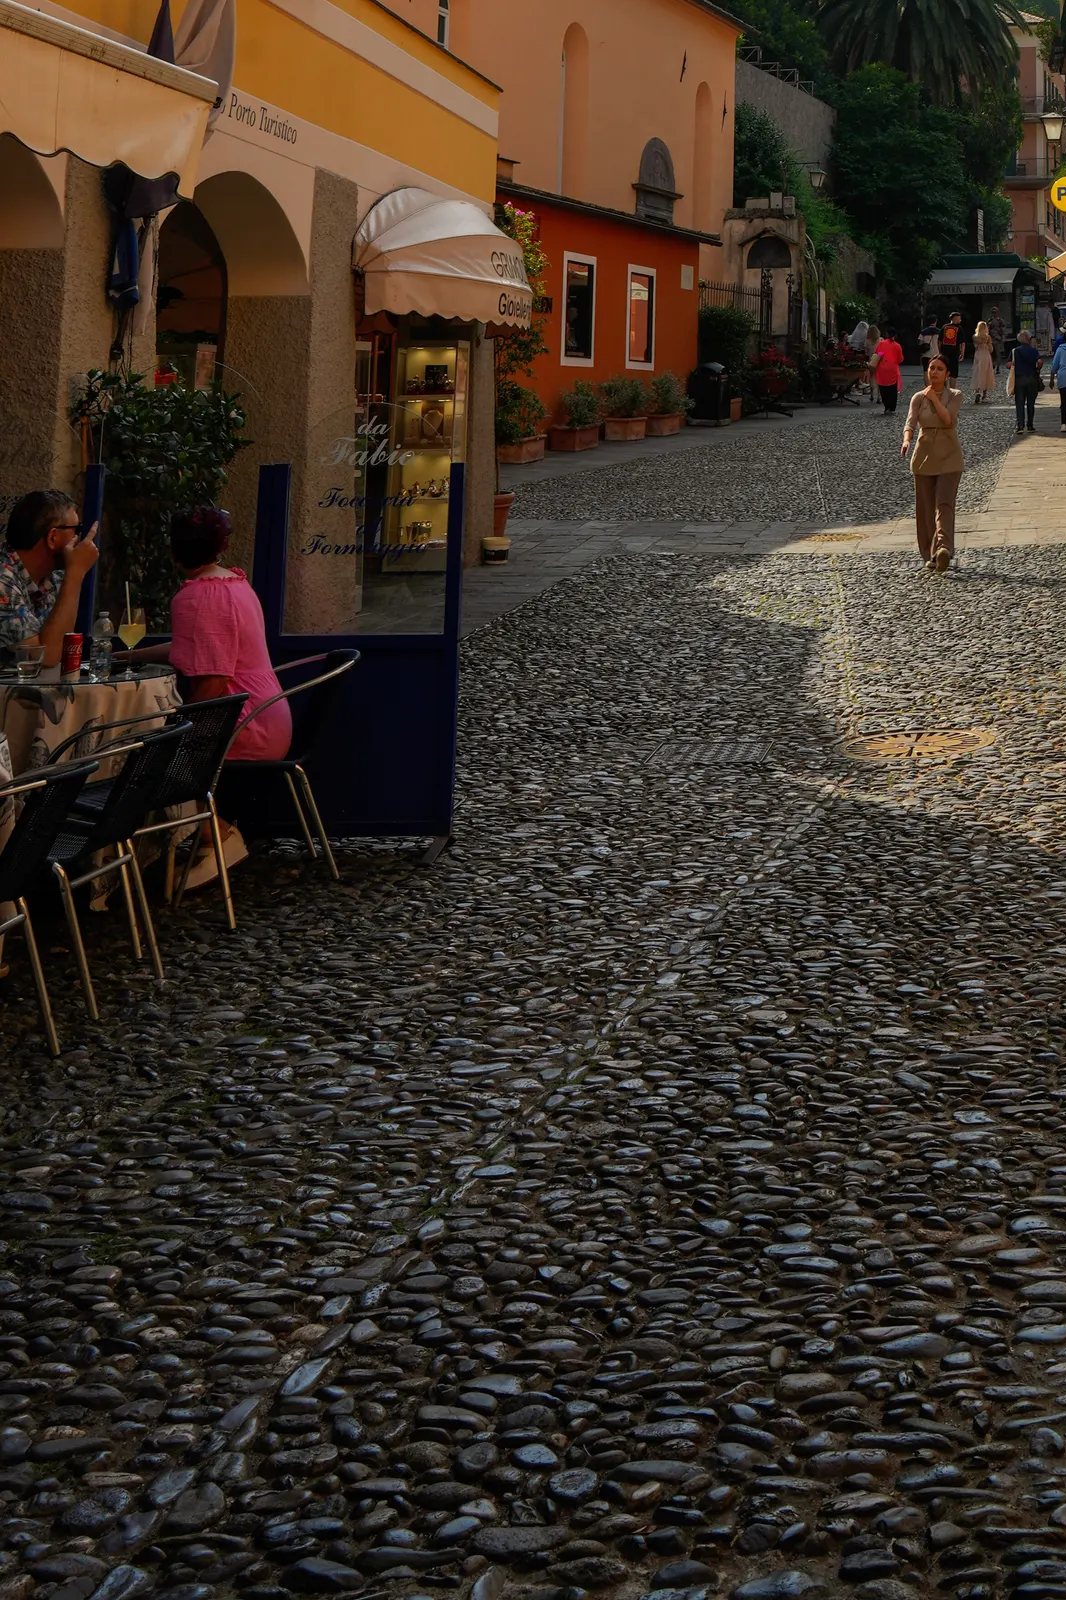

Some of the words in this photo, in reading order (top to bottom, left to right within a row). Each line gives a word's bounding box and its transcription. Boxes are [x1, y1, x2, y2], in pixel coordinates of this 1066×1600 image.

[228, 92, 256, 127] Porto
[259, 106, 297, 144] Turistico
[357, 415, 392, 435] da
[321, 436, 422, 467] Fabio
